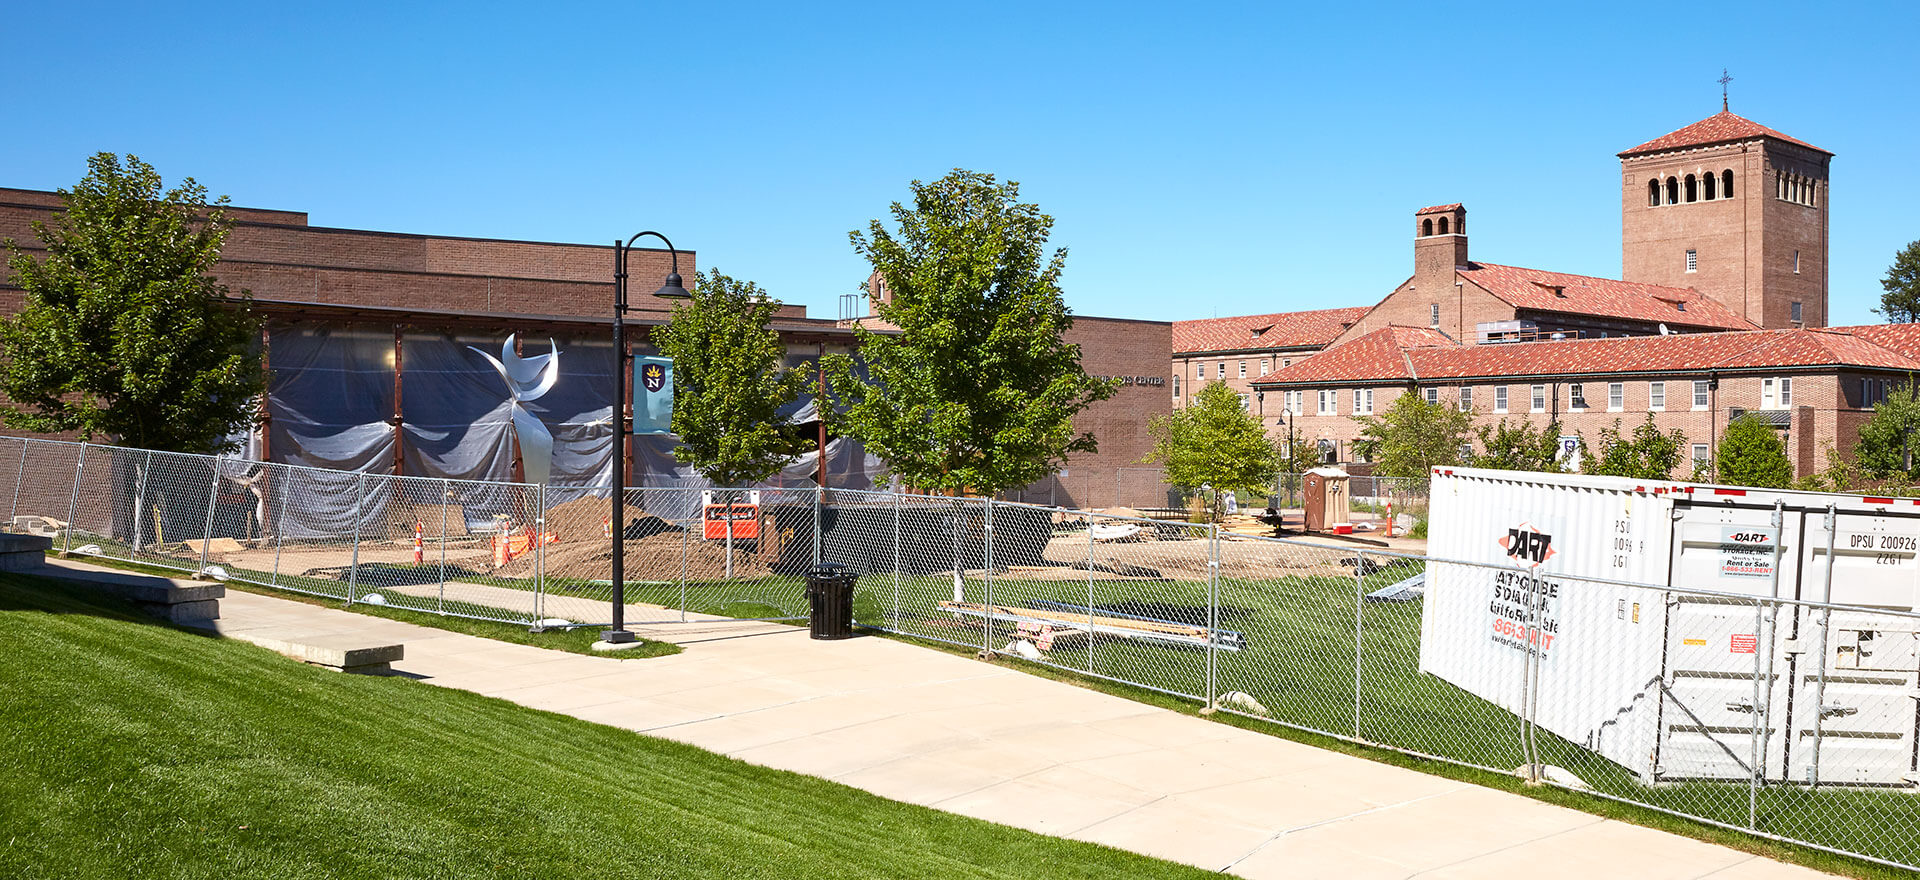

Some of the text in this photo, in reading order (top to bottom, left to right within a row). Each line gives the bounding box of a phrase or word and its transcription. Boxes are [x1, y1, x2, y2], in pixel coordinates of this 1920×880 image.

[647, 378, 660, 388] N
[1735, 533, 1766, 542] DART
[1851, 534, 1917, 550] DPSU 200926
[1507, 528, 1551, 563] DART
